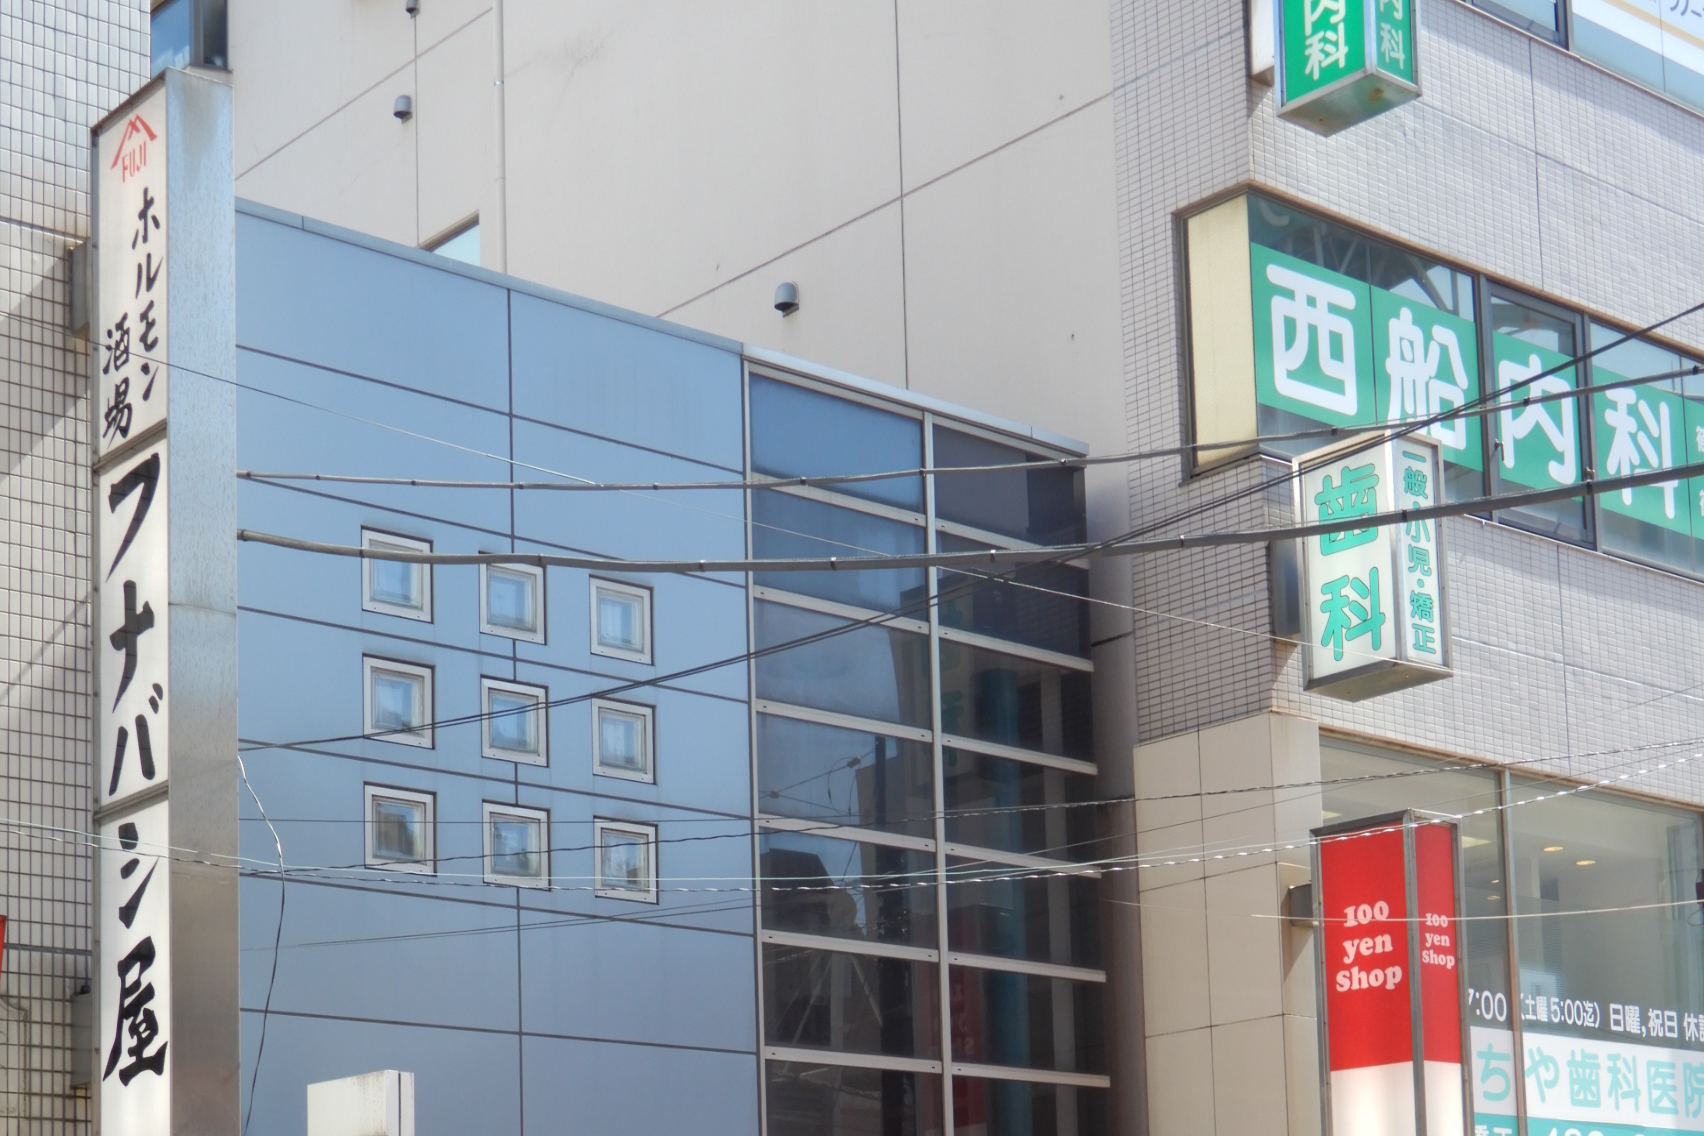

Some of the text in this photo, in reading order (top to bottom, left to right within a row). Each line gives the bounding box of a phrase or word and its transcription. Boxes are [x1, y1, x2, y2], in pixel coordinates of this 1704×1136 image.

[1304, 0, 1349, 80] 内科
[122, 140, 148, 183] FUJI
[132, 186, 163, 402] ホルモン
[103, 312, 133, 444] 酒場
[1266, 263, 1678, 519] 西船内科
[1315, 463, 1386, 662] 歯科
[103, 452, 168, 1087] フナバシ屋
[1342, 933, 1394, 964] yen
[1343, 900, 1390, 928] 100
[1425, 913, 1449, 928] 100
[1425, 932, 1450, 948] yen
